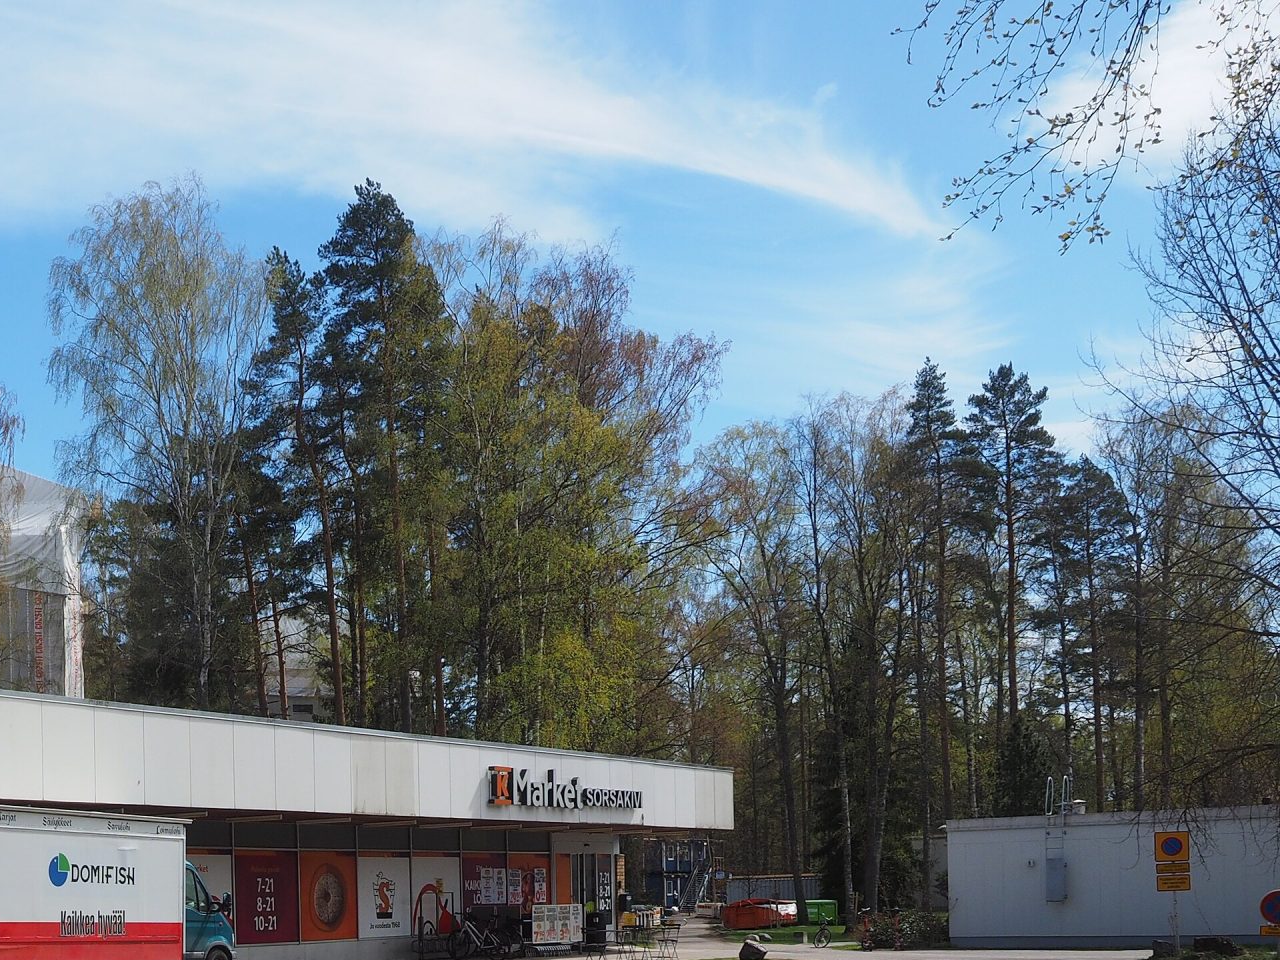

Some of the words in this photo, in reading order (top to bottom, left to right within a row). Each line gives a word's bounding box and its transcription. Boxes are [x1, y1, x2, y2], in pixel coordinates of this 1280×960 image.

[513, 767, 584, 809] Market
[71, 864, 136, 885] DOMIFISH
[256, 878, 274, 893] 7-21
[256, 896, 275, 912] 8-21
[60, 910, 95, 936] Kaikkea
[97, 910, 127, 939] hyvää!
[253, 915, 278, 931] 10-21
